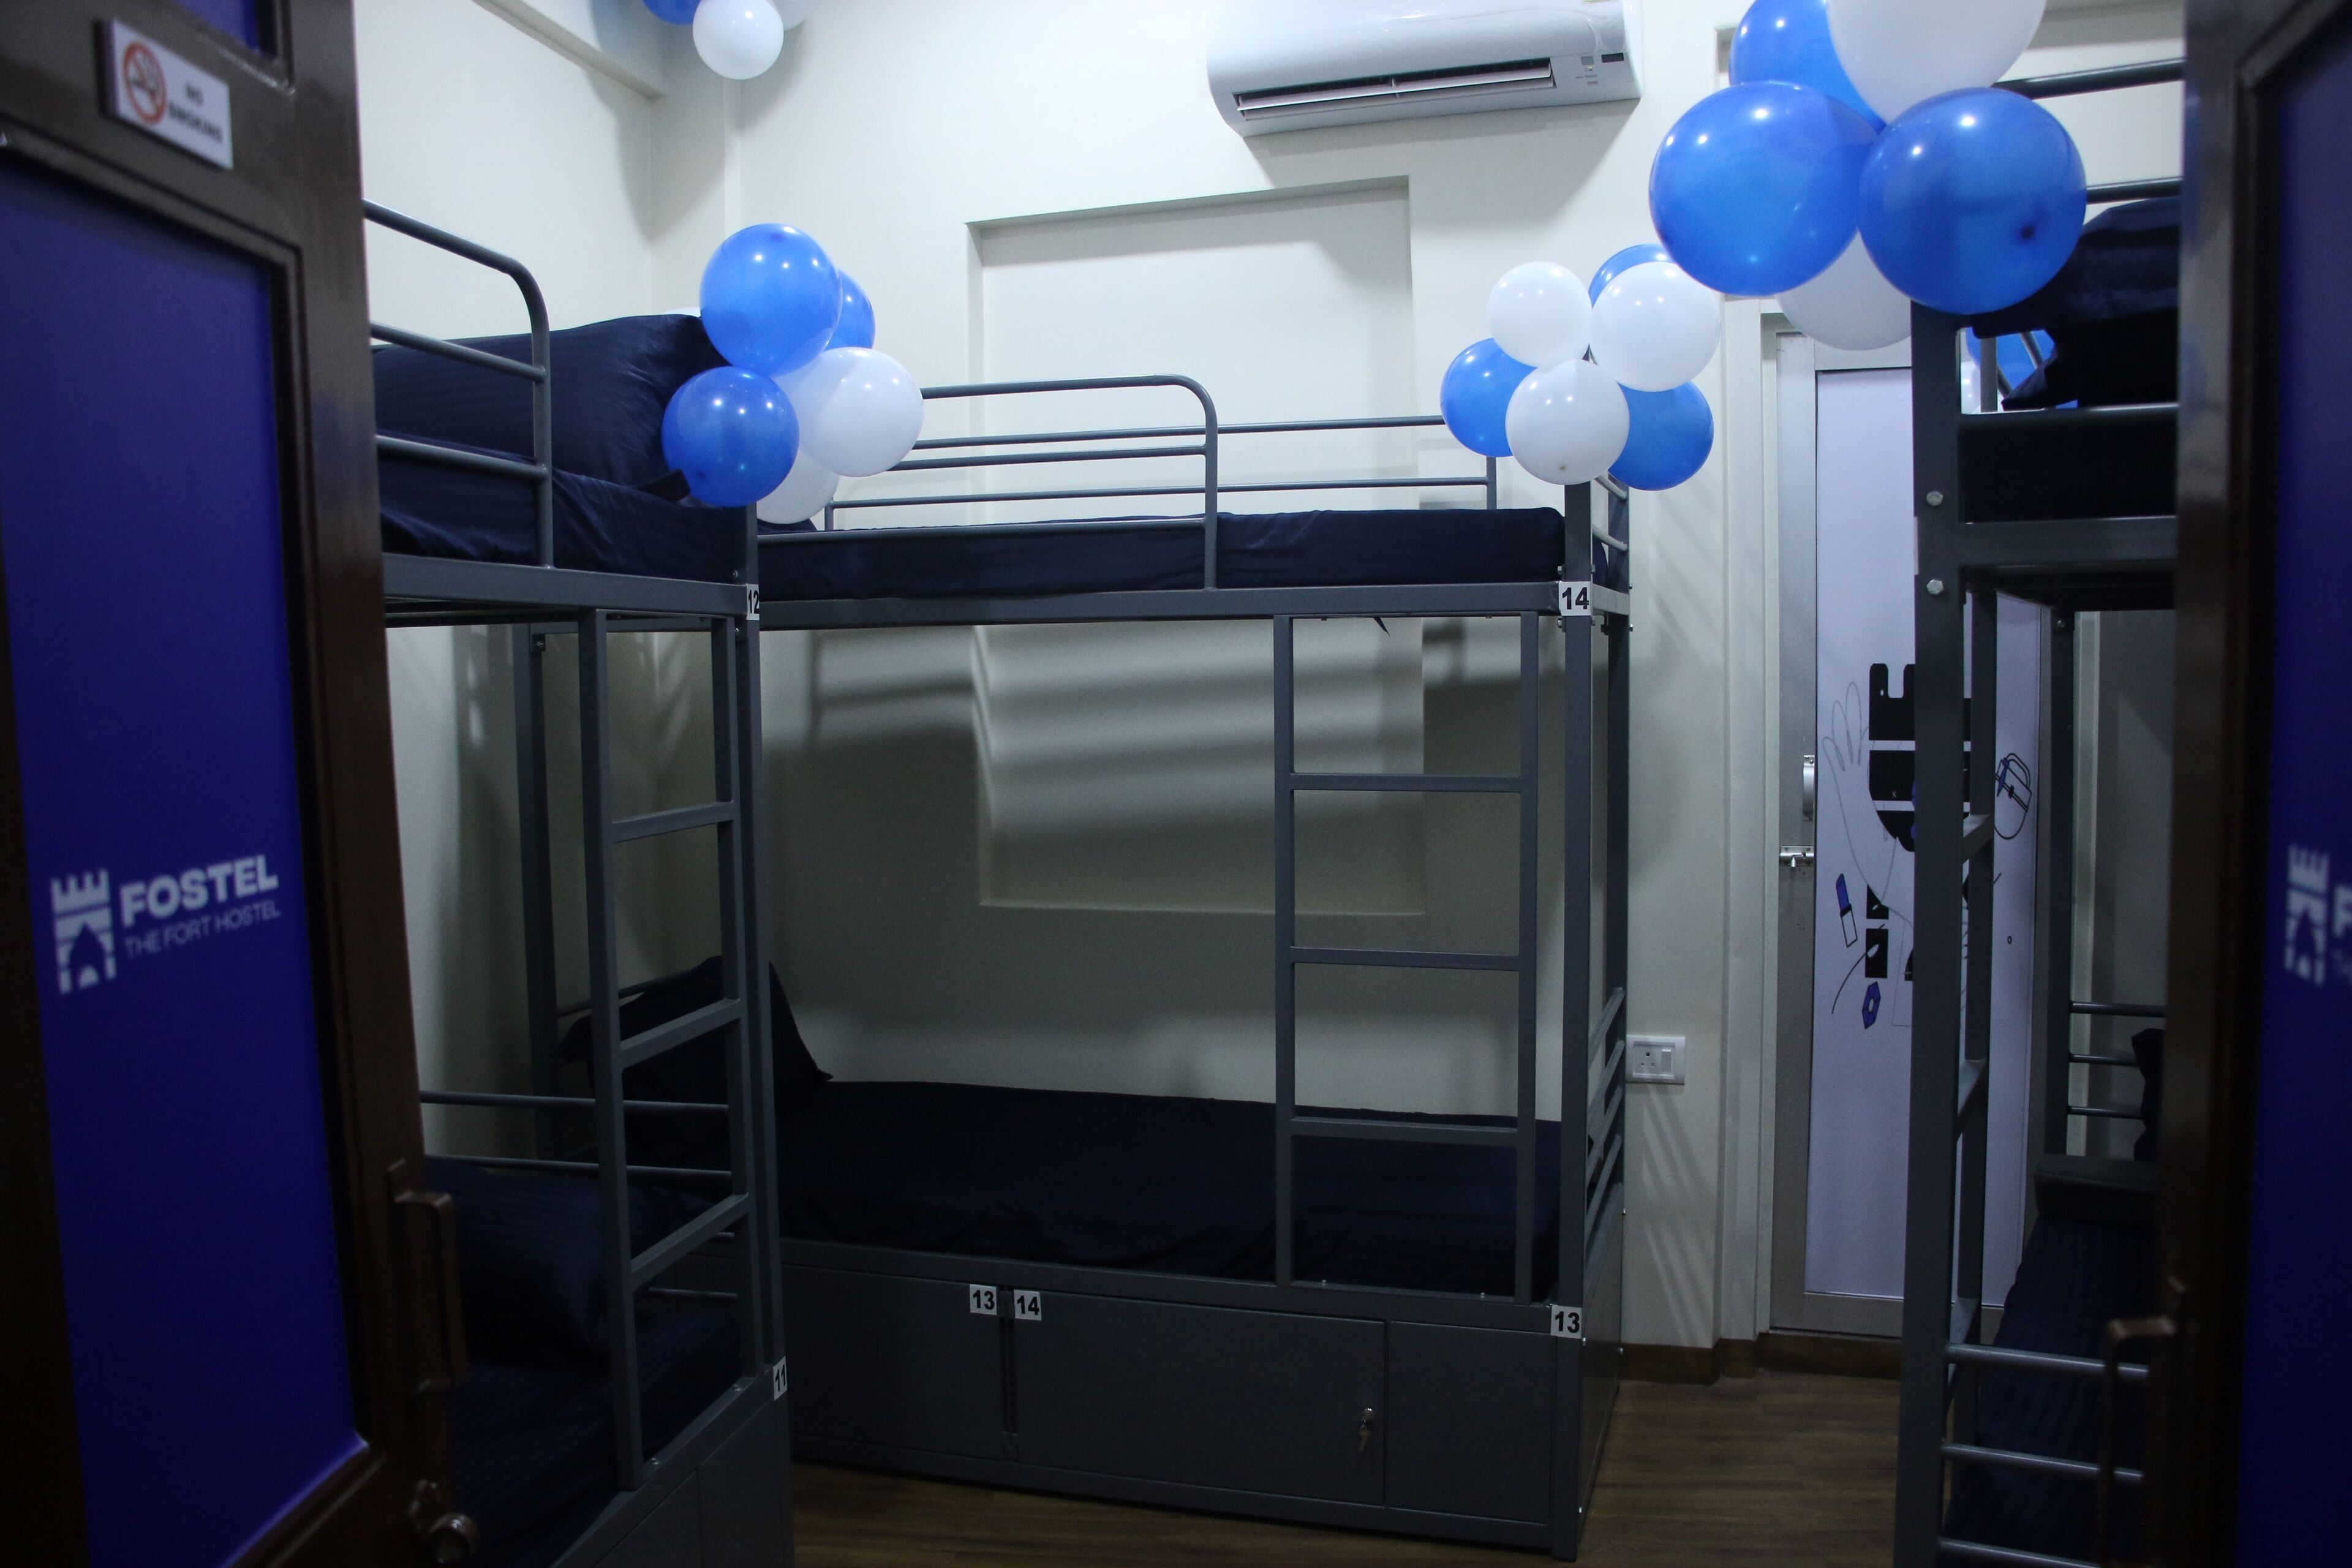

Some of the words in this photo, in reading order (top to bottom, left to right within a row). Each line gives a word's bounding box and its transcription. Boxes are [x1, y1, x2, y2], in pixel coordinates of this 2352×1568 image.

[748, 590, 760, 614] 12
[1562, 587, 1589, 610] 14
[120, 854, 279, 927] FOSTEL
[125, 929, 161, 958] THE
[162, 916, 211, 946] FORT
[215, 899, 281, 933] HOSTEL
[973, 1289, 995, 1310] 13
[1017, 1295, 1039, 1316] 14
[1555, 1311, 1580, 1333] 13
[775, 1363, 786, 1392] 11
